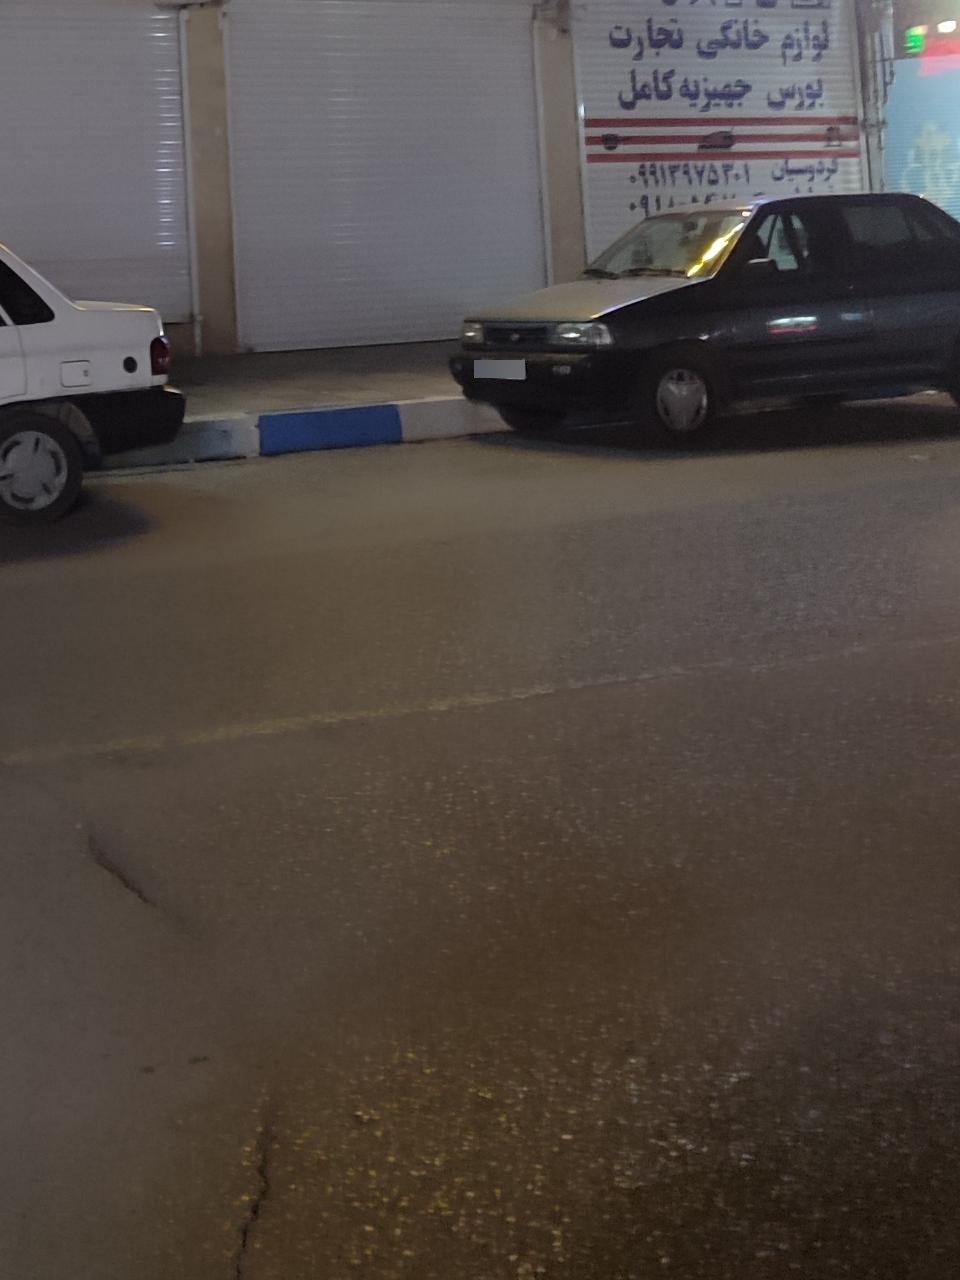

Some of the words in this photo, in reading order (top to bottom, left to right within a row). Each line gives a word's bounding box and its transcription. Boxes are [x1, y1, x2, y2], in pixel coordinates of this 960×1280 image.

[609, 18, 684, 61] تجارت
[696, 19, 770, 60] خانگی
[781, 19, 830, 66] لوازم
[618, 68, 676, 111] کامل
[767, 78, 824, 111] بورس
